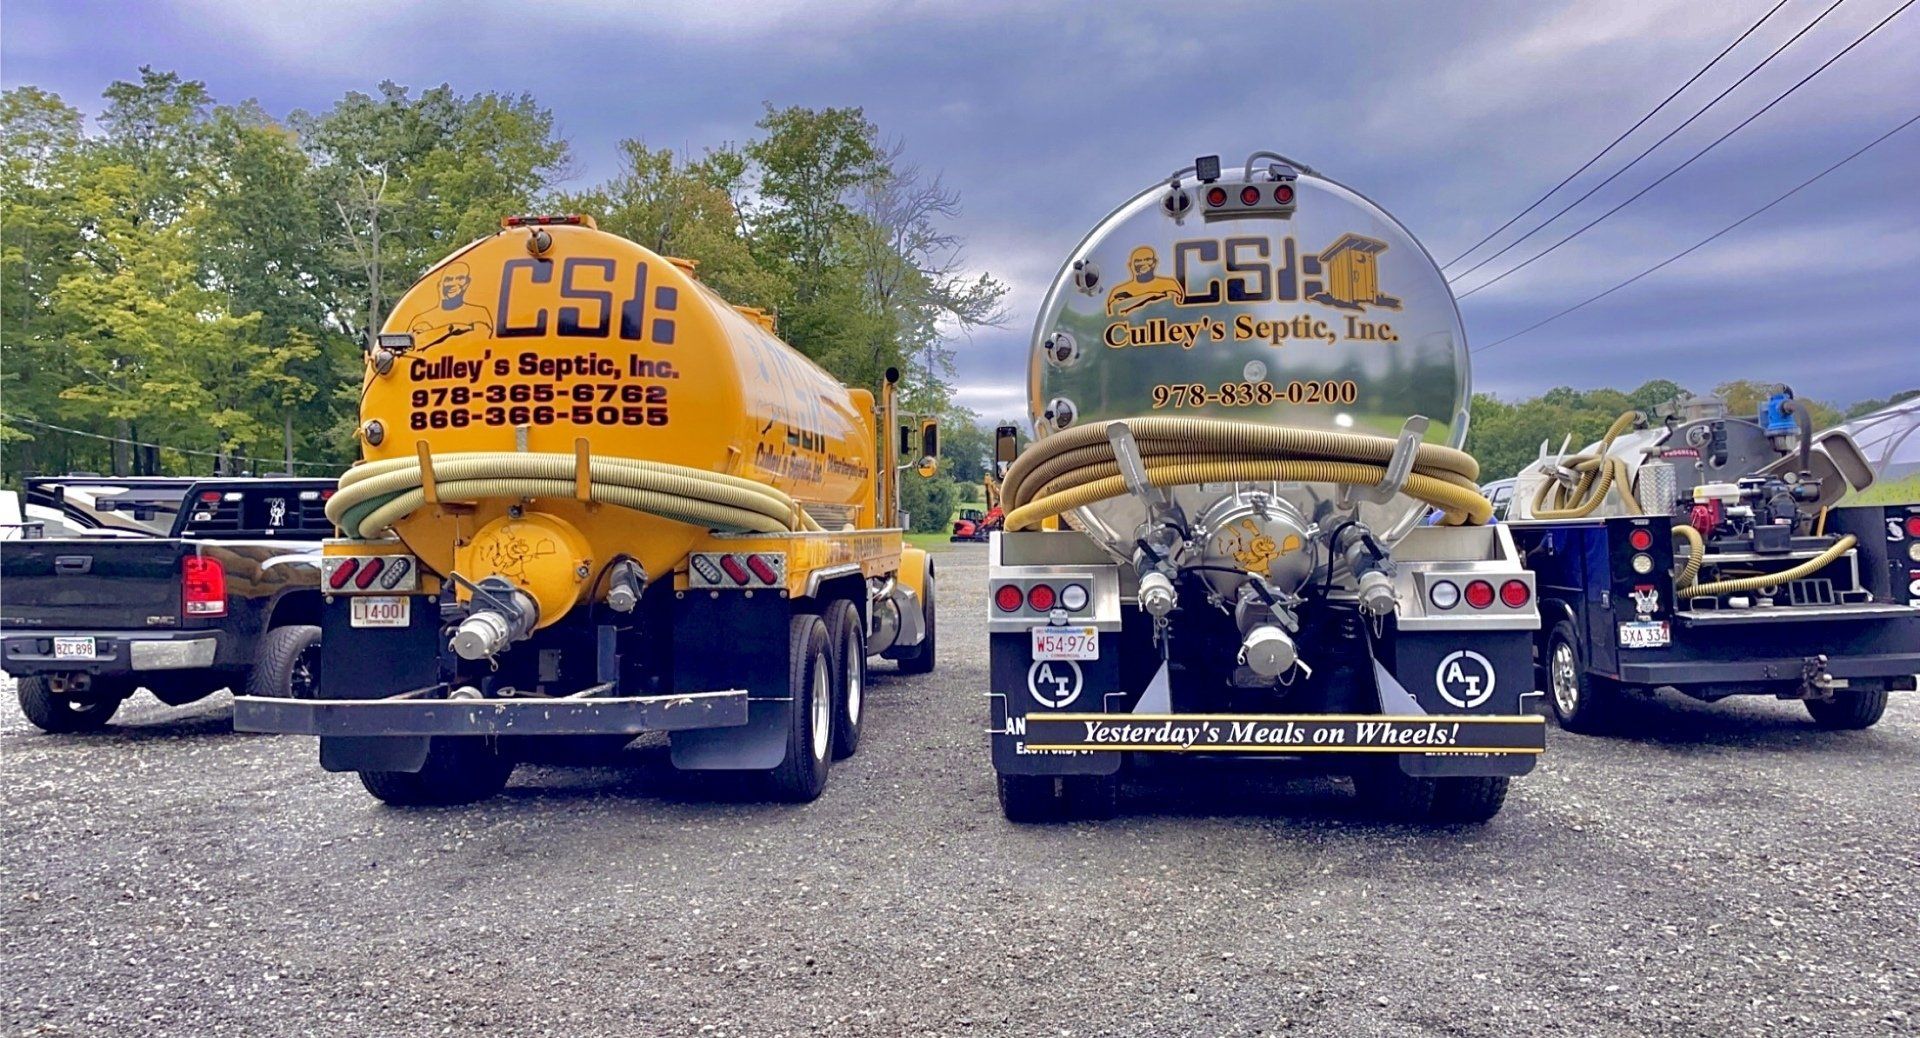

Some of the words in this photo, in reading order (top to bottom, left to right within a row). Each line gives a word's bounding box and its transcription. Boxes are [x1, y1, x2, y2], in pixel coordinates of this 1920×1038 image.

[1105, 316, 1226, 349] Culley's
[1234, 313, 1337, 346] Septic,
[1343, 314, 1400, 342] Inc.
[410, 349, 511, 384] Culley's
[517, 351, 622, 382] Septic,
[629, 353, 680, 380] Inc.
[411, 383, 669, 409] 978-365-6762
[1152, 381, 1358, 409] 978-838-0200
[409, 405, 669, 431] 866-366-5055
[1646, 629, 1668, 641] 334
[1083, 721, 1220, 748] Yesterday's
[1226, 722, 1305, 744] Meals
[1312, 726, 1346, 744] on
[1354, 722, 1460, 745] Wheels!
